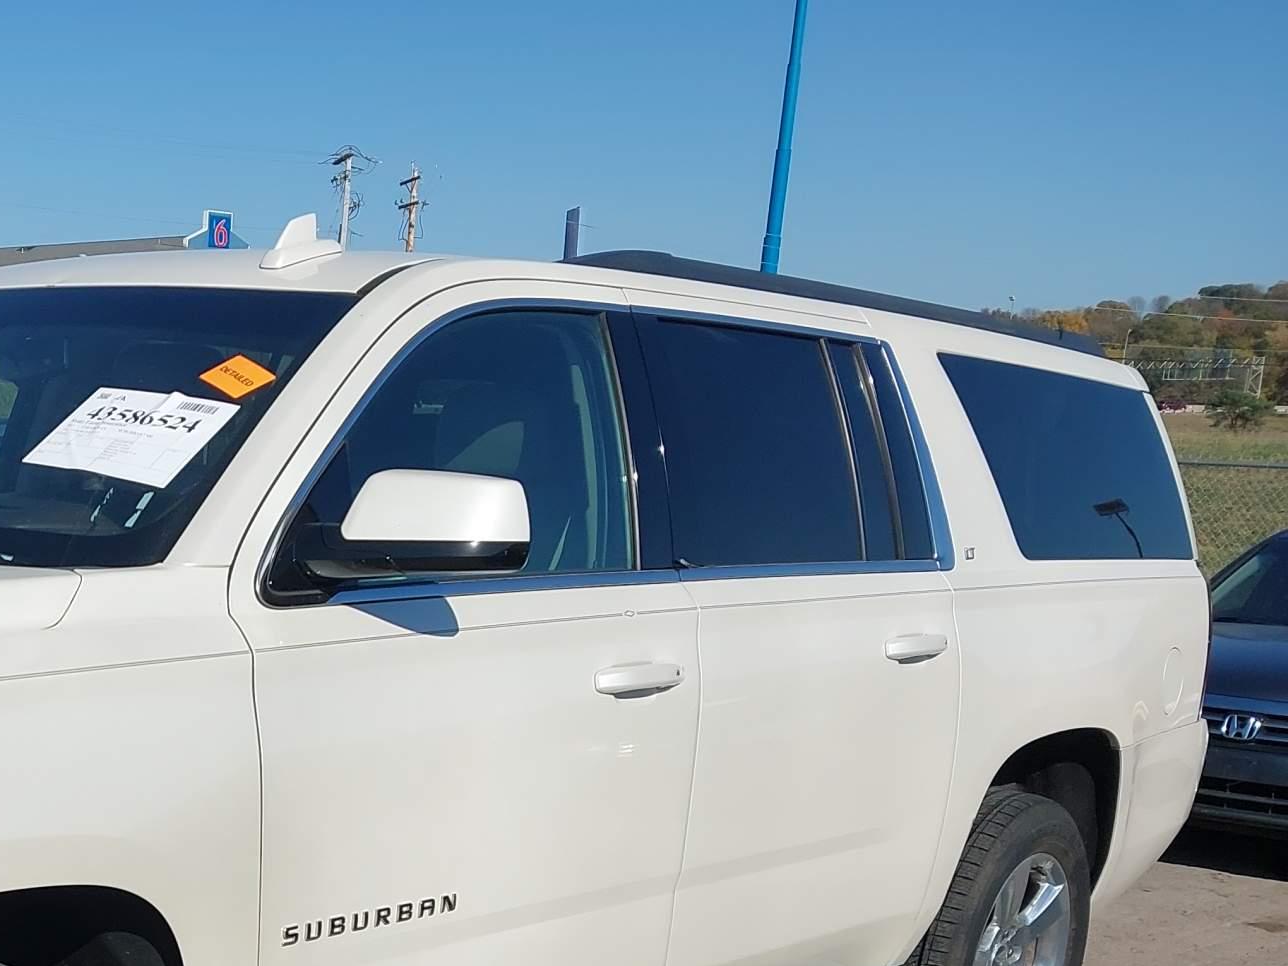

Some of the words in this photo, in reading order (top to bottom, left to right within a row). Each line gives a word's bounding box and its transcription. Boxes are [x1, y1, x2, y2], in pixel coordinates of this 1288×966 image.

[214, 219, 228, 248] 6
[219, 365, 254, 387] DETAILED
[87, 405, 202, 433] 43586524
[280, 892, 458, 947] SUBURBAN
